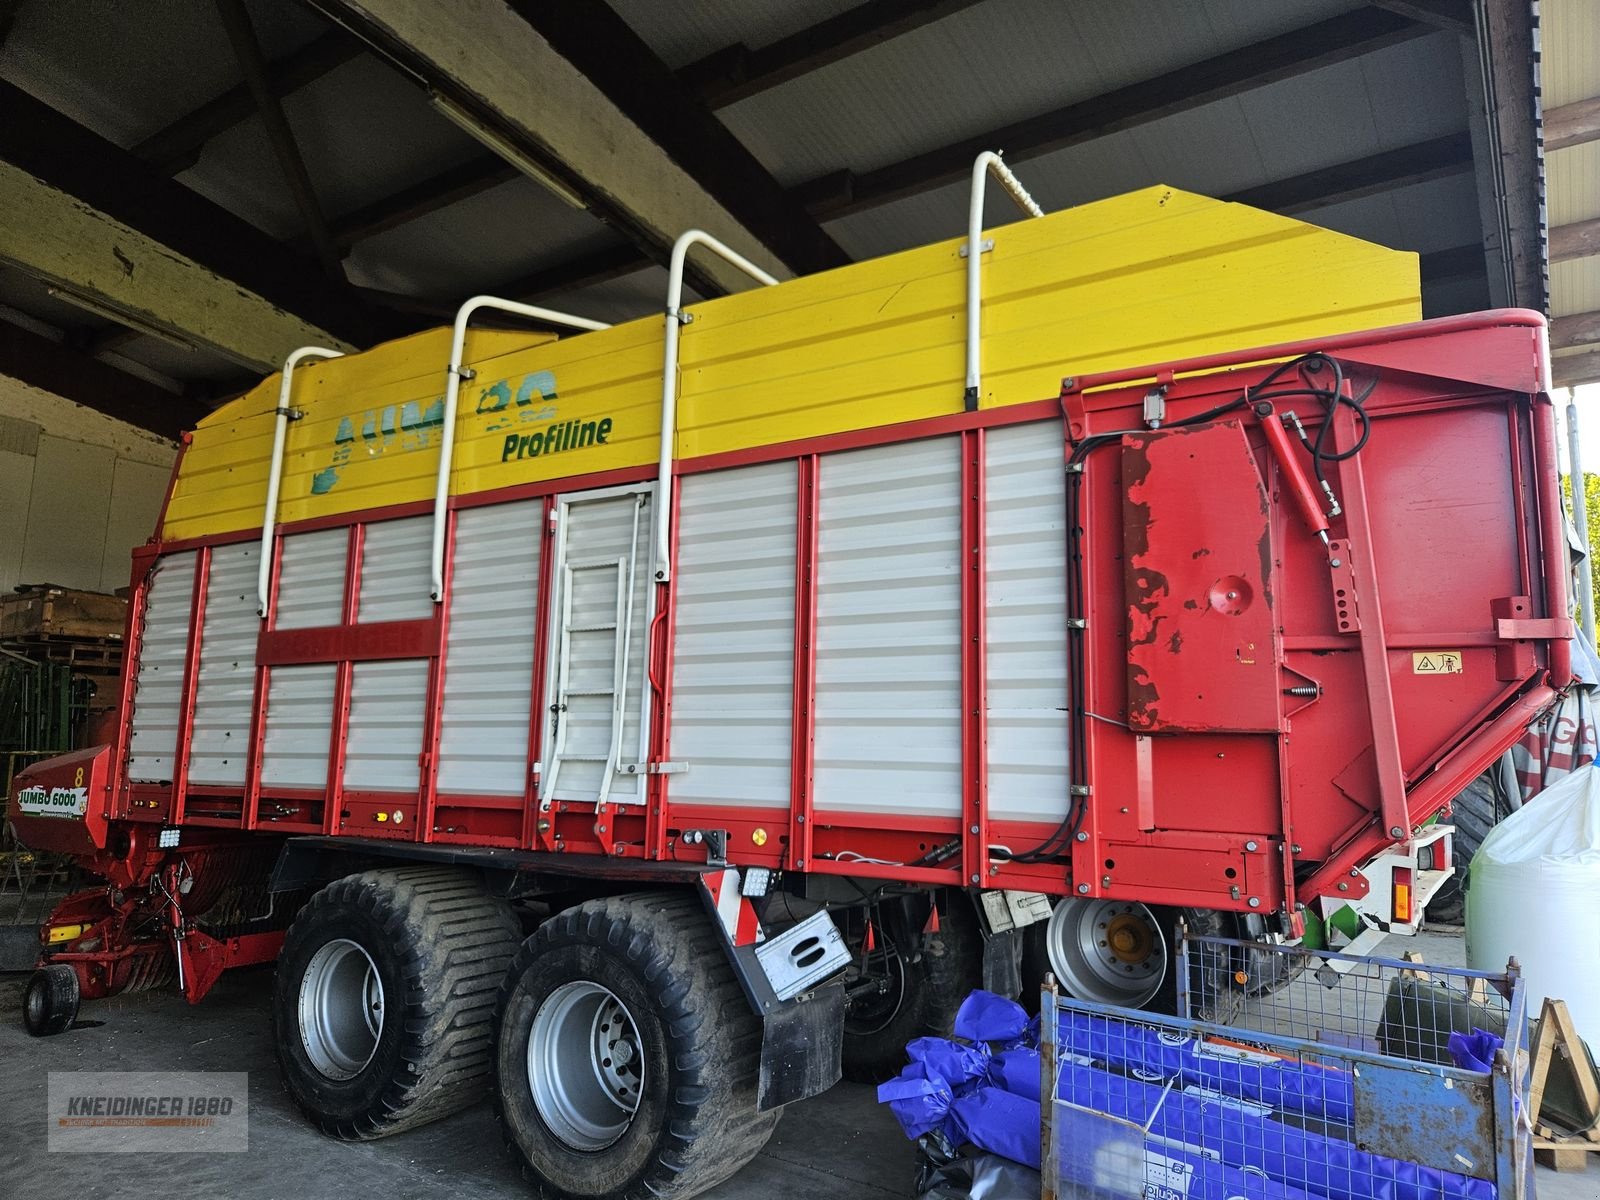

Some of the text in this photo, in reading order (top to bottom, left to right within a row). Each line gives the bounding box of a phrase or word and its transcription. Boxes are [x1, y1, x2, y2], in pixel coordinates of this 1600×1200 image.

[501, 417, 612, 462] Profiline
[74, 767, 84, 788] 8
[20, 791, 77, 807] JUMBO 6000
